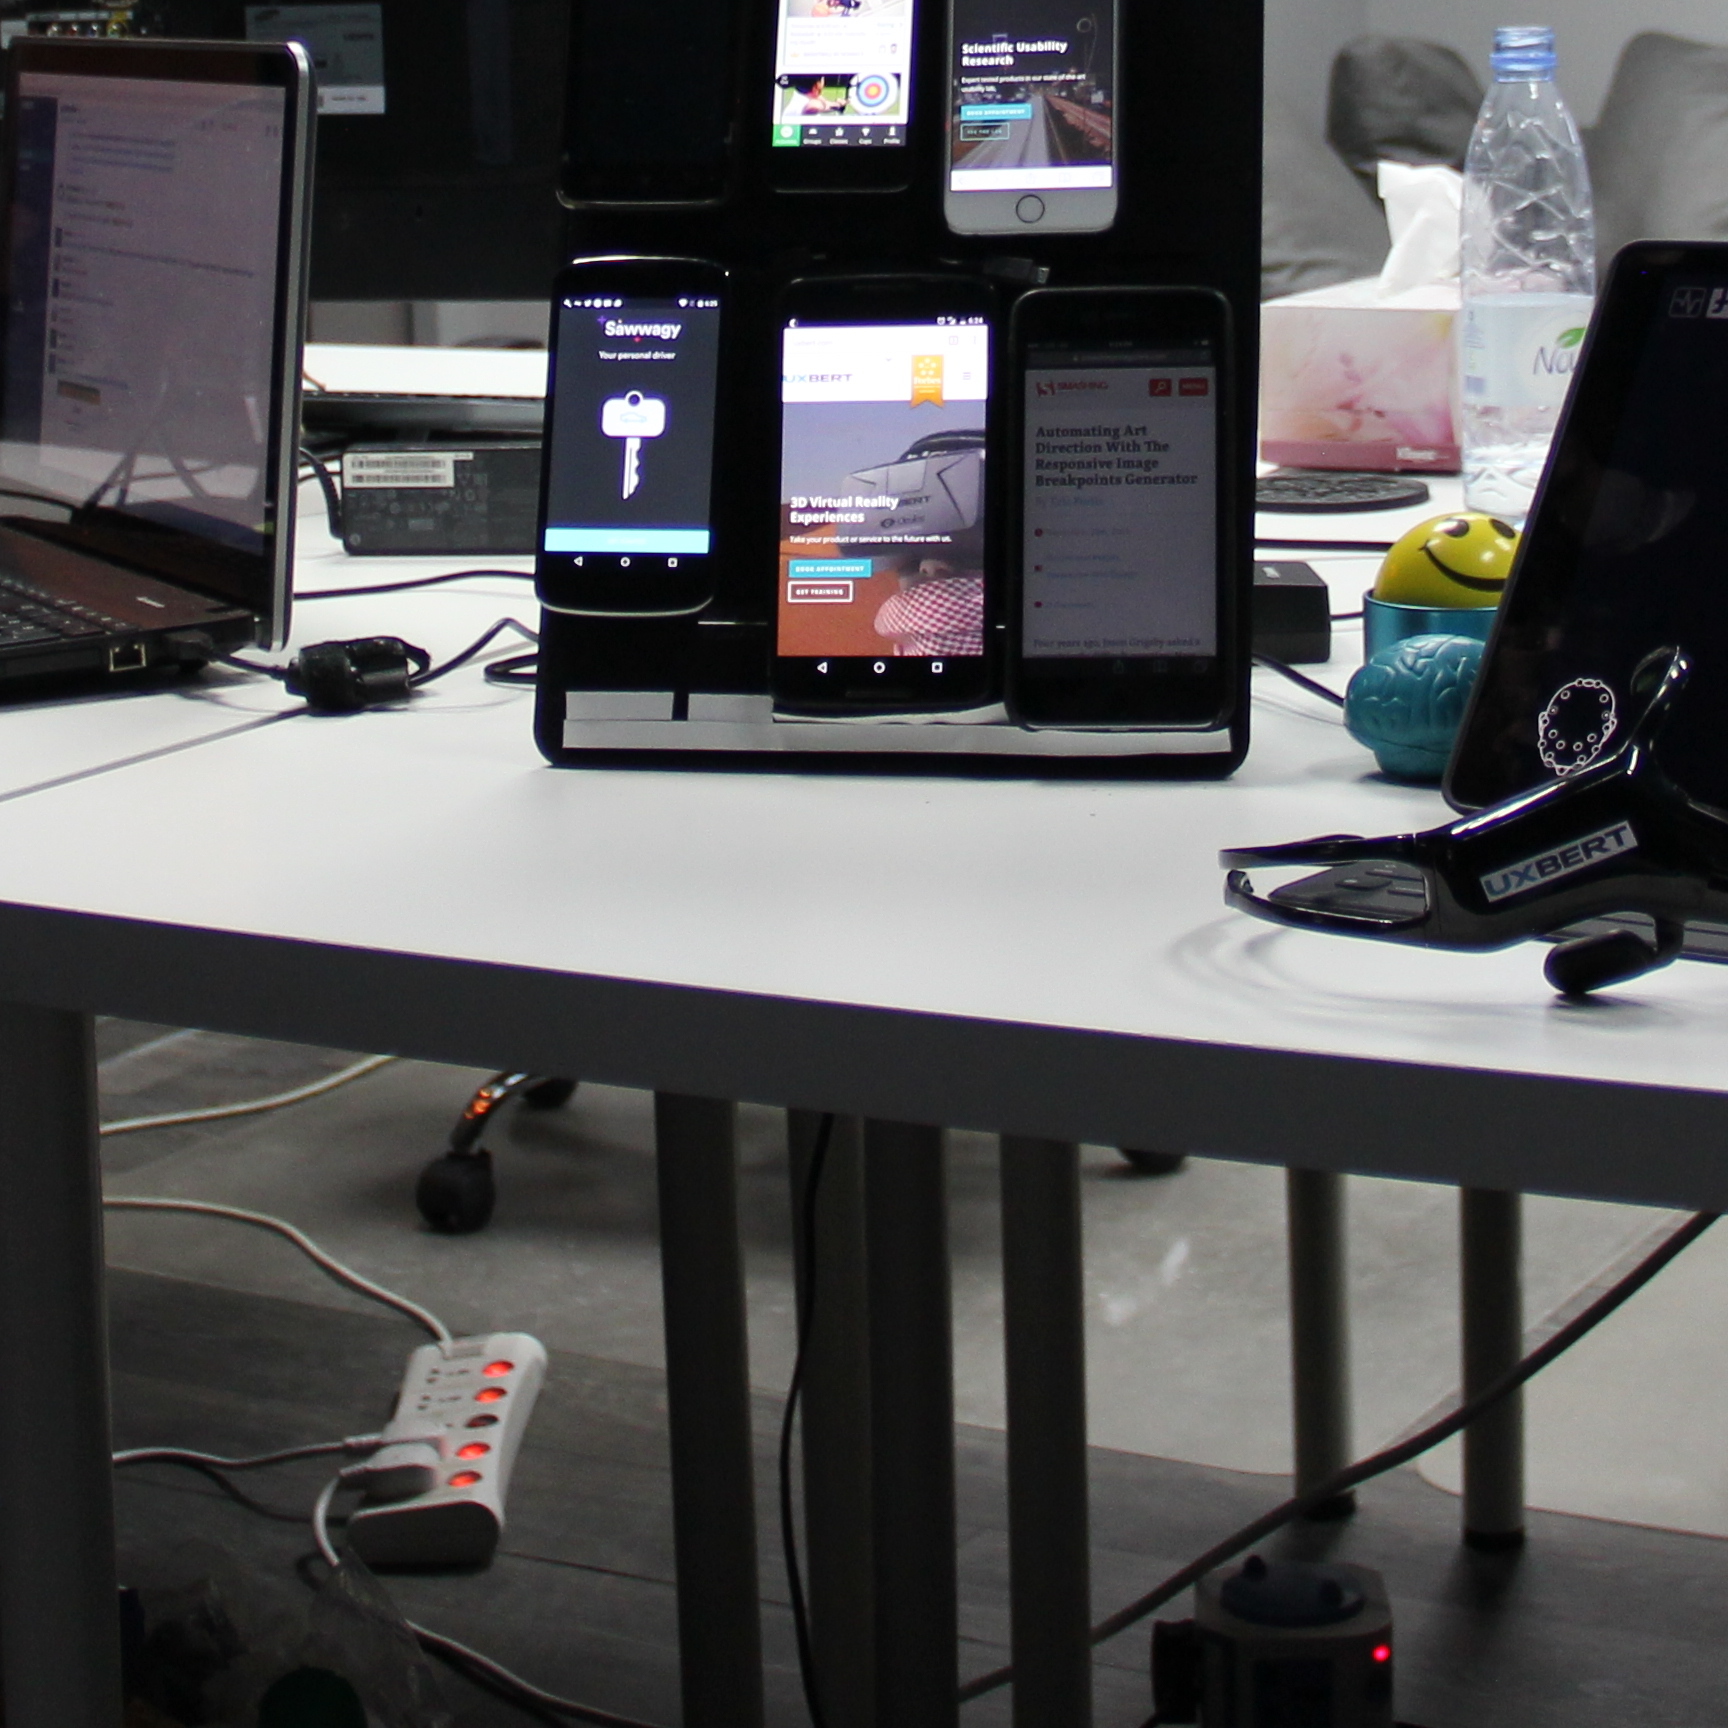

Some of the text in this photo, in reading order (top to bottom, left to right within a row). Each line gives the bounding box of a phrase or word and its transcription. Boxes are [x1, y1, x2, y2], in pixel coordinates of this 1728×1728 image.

[962, 41, 1068, 55] Scientific Usability
[962, 55, 1014, 67] Research
[605, 320, 682, 340] Sawwagy
[599, 351, 676, 361] Your personal driver
[782, 374, 853, 383] UXBERT
[1035, 424, 1148, 440] Automating Art
[1035, 440, 1170, 454] Direction With The
[1035, 457, 1160, 472] Responsive Image
[1035, 473, 1198, 489] Breakpoints Generator
[790, 496, 808, 509] 3D
[809, 496, 853, 509] Virtual
[855, 495, 899, 511] Reality
[790, 511, 866, 525] Experiences
[790, 535, 805, 544] Take
[806, 536, 822, 545] your
[823, 535, 849, 545] product
[859, 535, 882, 544] service
[903, 534, 925, 543] future
[925, 535, 940, 543] with
[1484, 826, 1627, 897] UXBERT
